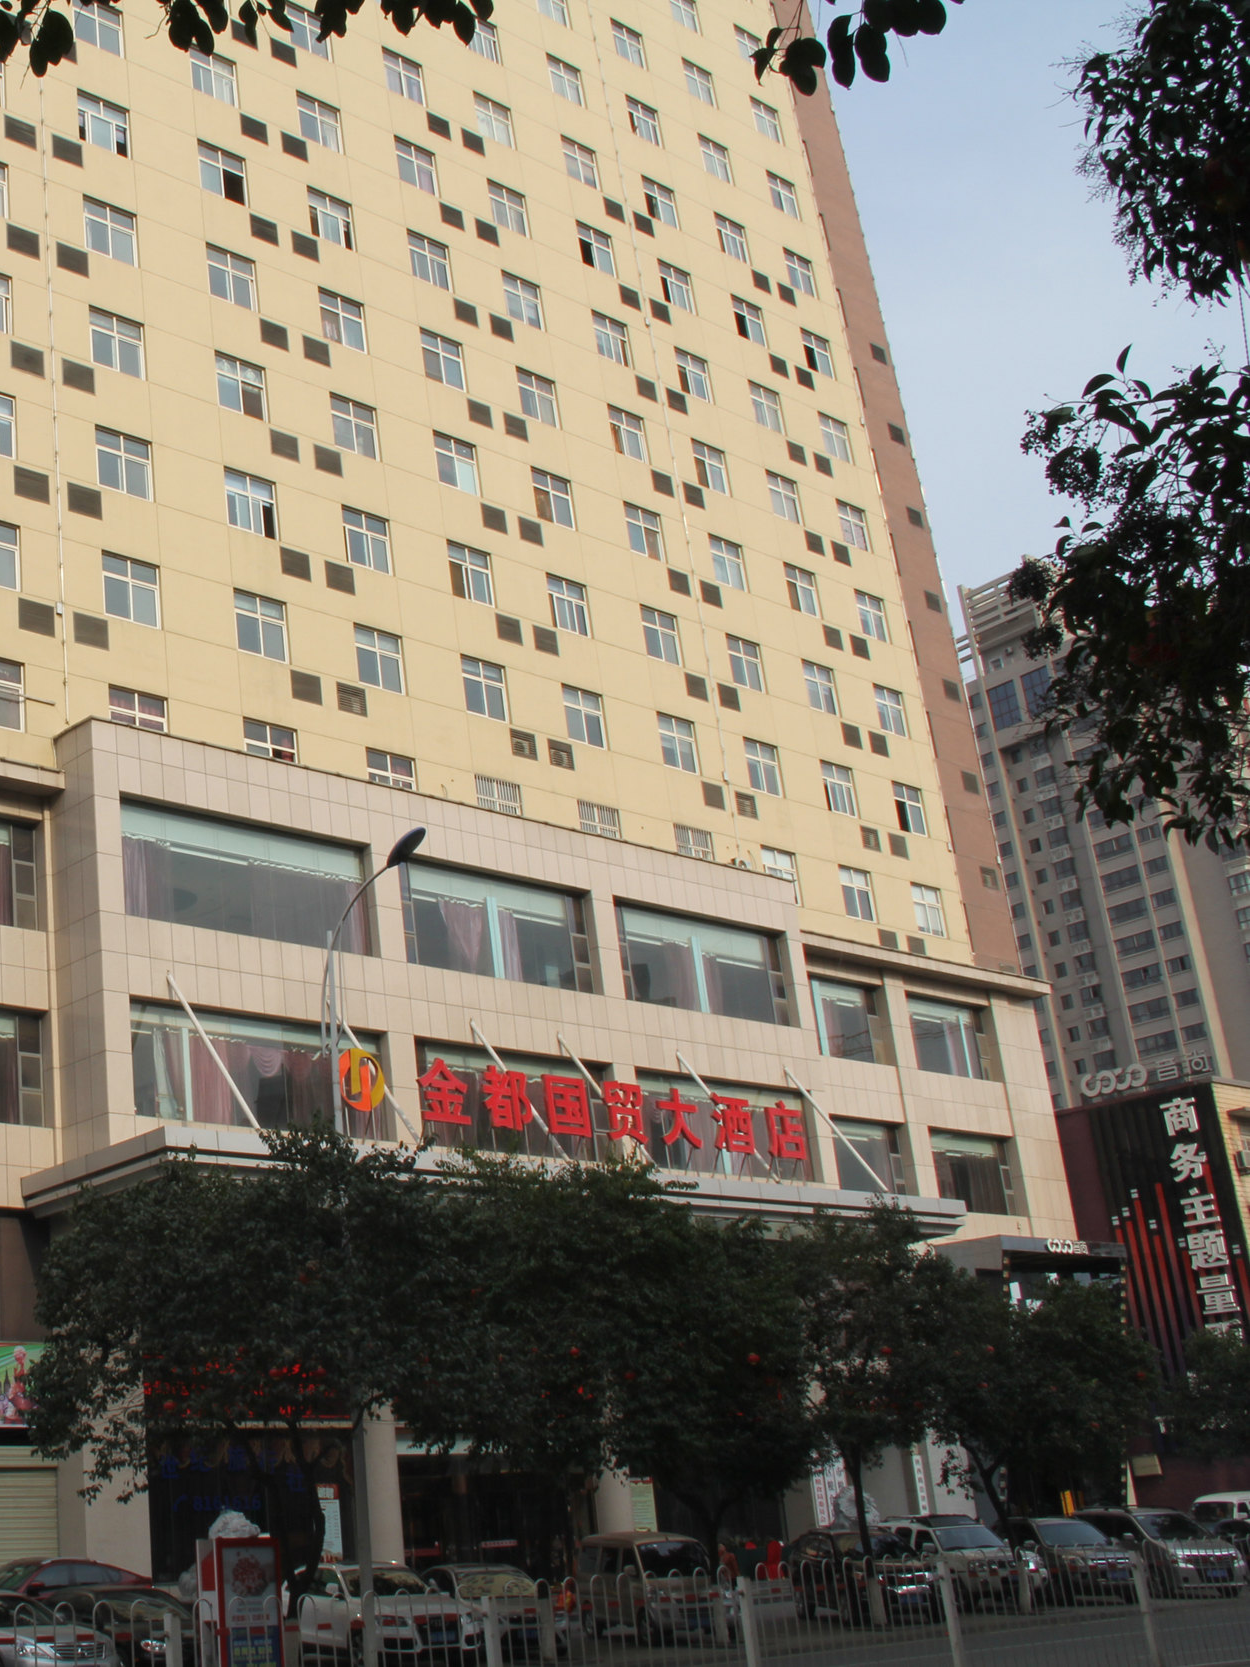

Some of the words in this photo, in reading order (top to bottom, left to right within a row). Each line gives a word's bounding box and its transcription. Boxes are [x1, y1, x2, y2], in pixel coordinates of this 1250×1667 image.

[417, 1057, 807, 1161] 金都国贸大酒店
